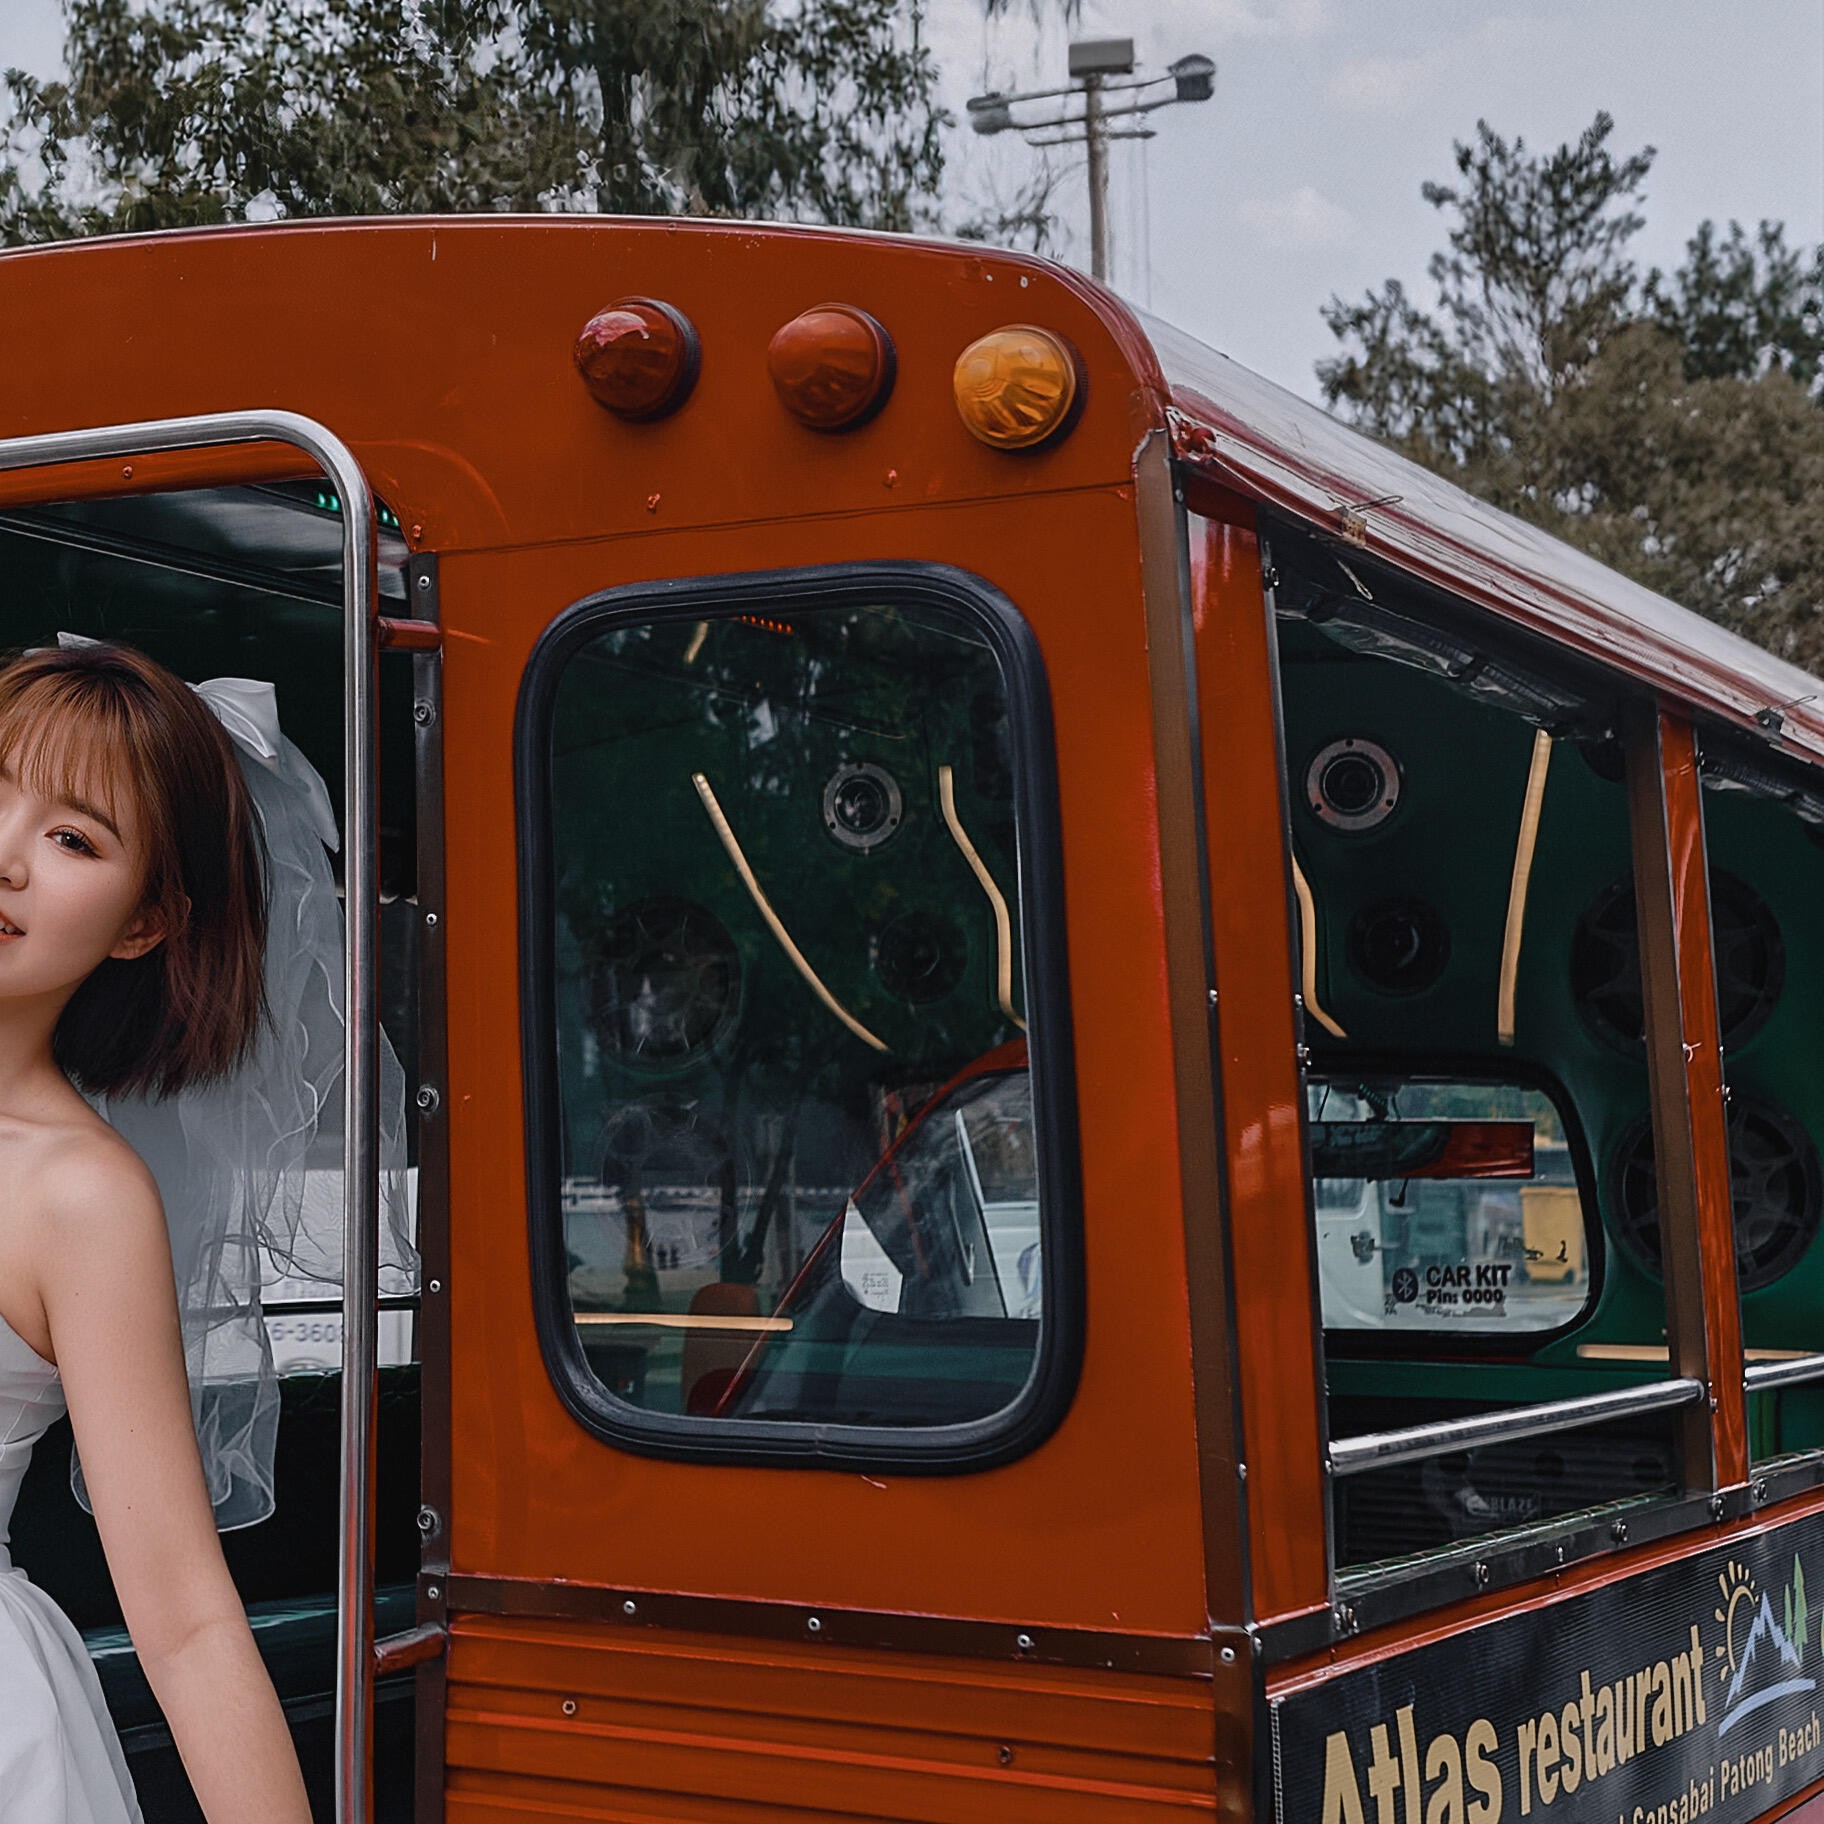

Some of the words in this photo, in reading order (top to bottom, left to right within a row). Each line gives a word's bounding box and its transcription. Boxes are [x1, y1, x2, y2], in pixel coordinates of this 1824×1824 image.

[1427, 1265, 1471, 1287] CAR
[1475, 1264, 1512, 1287] KIT
[1427, 1289, 1458, 1304] Pin:
[1462, 1289, 1504, 1304] 0000
[1516, 1625, 1707, 1816] restaurant
[1721, 1745, 1773, 1801] Patong
[1779, 1710, 1820, 1767] Beach
